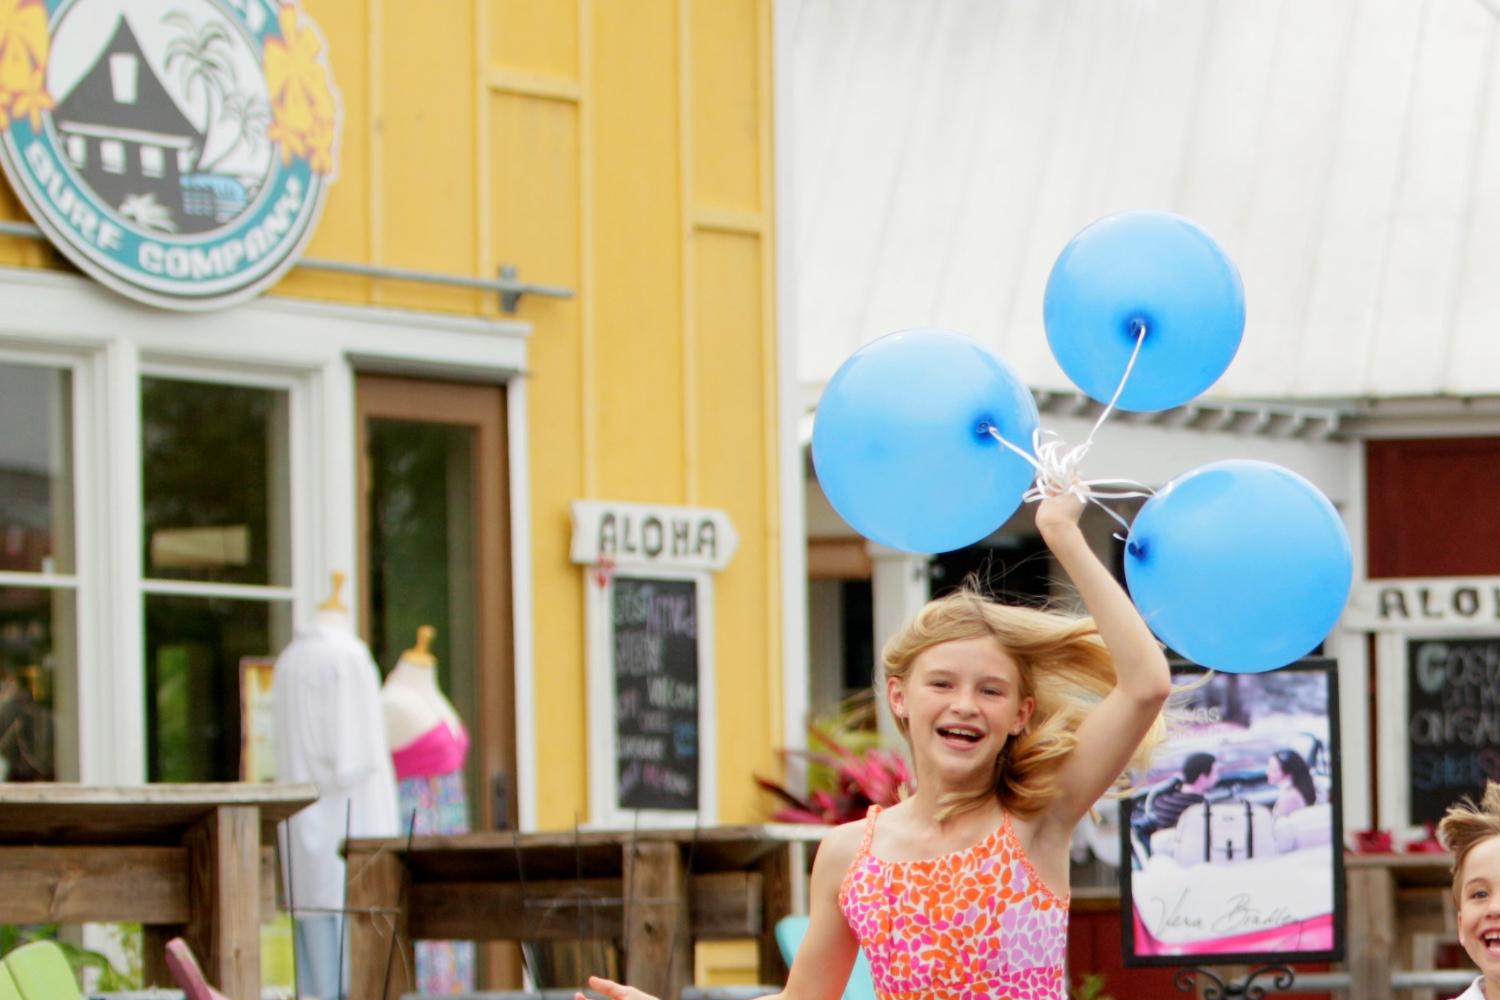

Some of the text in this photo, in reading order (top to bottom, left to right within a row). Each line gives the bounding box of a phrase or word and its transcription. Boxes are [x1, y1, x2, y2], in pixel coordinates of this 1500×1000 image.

[138, 175, 300, 279] COMPANY
[599, 511, 716, 557] ALOHA
[1150, 886, 1203, 937] Vera
